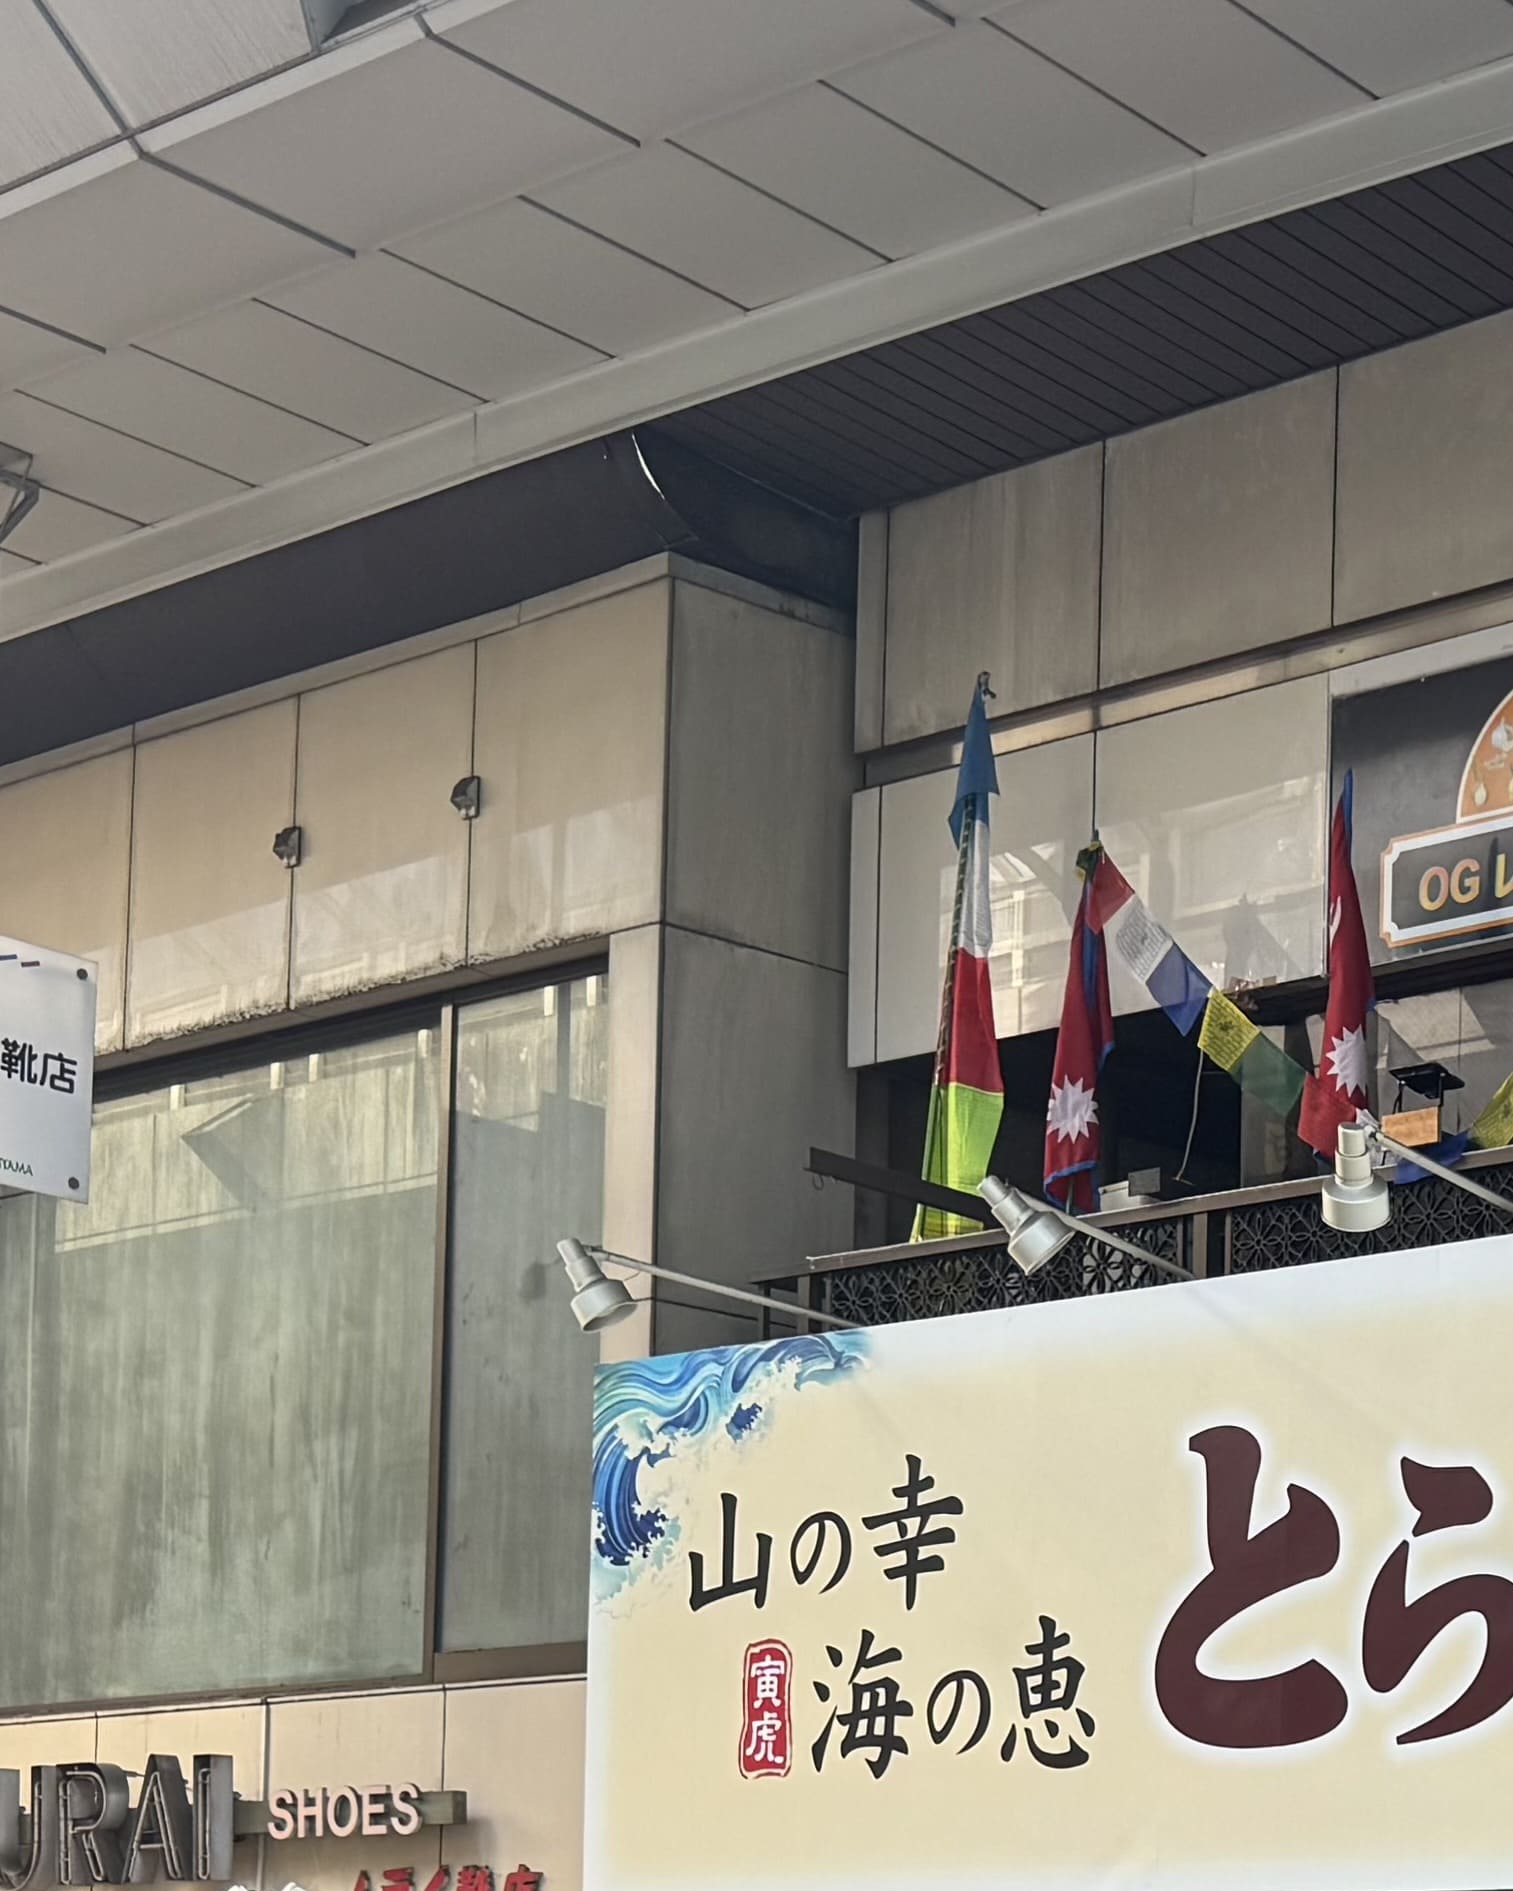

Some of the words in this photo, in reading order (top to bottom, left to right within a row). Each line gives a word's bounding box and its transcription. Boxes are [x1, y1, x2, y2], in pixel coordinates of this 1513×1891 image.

[1419, 858, 1480, 912] OG
[688, 1453, 964, 1612] 山の幸
[749, 1653, 786, 1764] 寅虎
[811, 1615, 1096, 1780] 海の恵
[267, 1782, 422, 1841] SHOES
